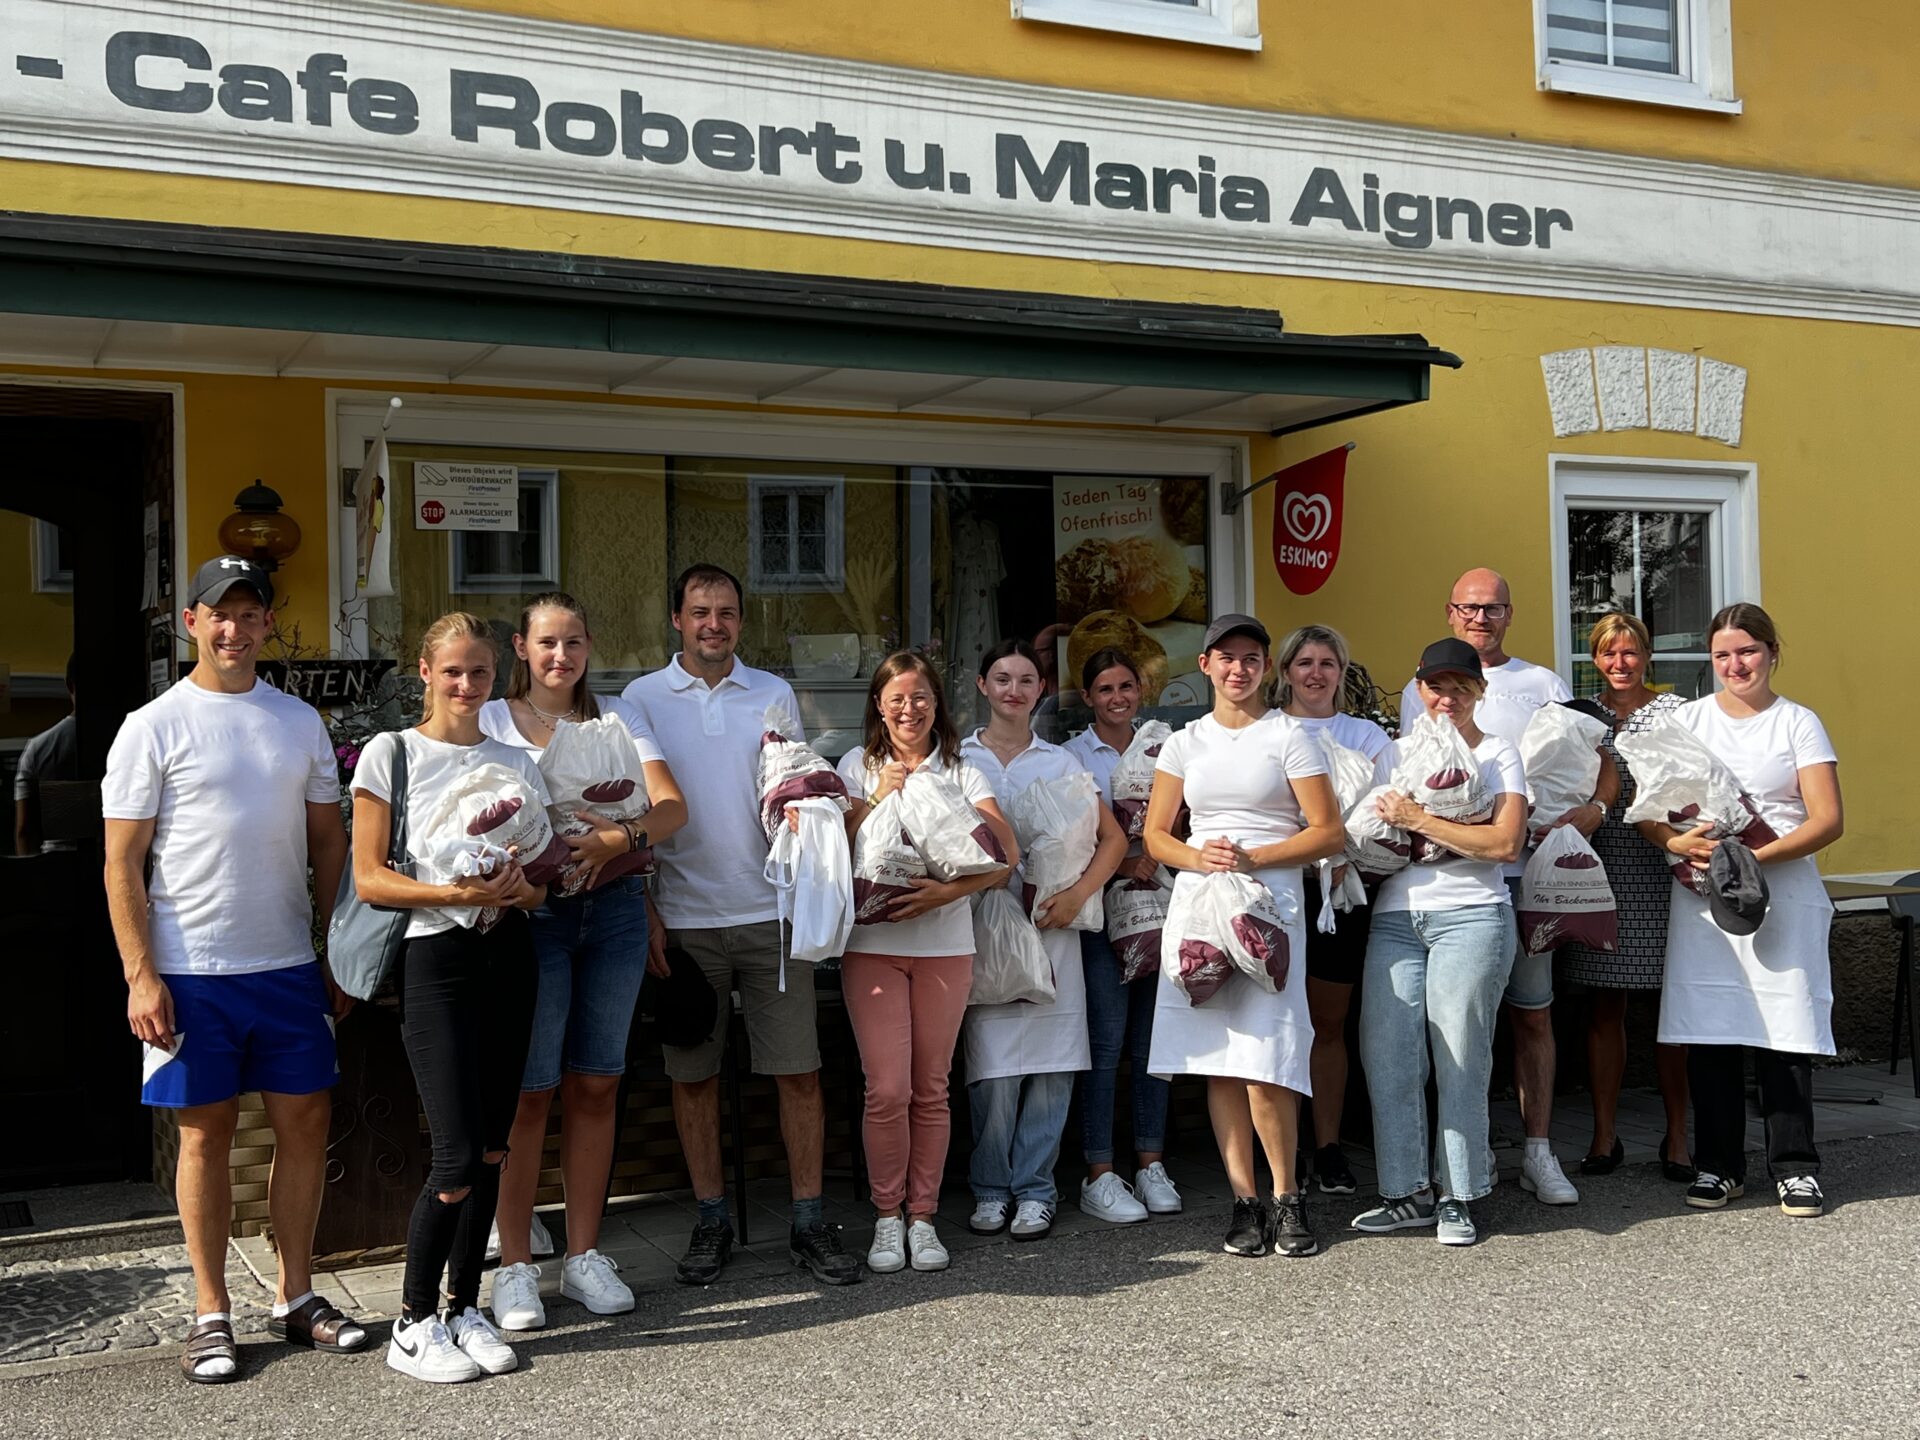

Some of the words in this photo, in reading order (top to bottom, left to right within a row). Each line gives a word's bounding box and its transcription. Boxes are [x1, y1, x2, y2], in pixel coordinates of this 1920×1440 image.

[105, 30, 419, 136] Cafe
[450, 68, 863, 184] Robert
[885, 138, 971, 194] u.
[996, 132, 1271, 223] Maria
[1289, 166, 1574, 250] Aigner
[449, 466, 472, 474] Dieses
[473, 467, 496, 476] Objekt
[449, 475, 513, 485] VIDEOÜBERWACHT
[1061, 488, 1111, 506] Jeden
[1115, 483, 1147, 502] Tag
[422, 507, 444, 518] STOP
[449, 508, 513, 517] ALARMGESICHERT
[1060, 506, 1153, 532] Ofenfrisch!
[1279, 544, 1328, 570] ESKIMO
[1534, 893, 1549, 904] Ihr
